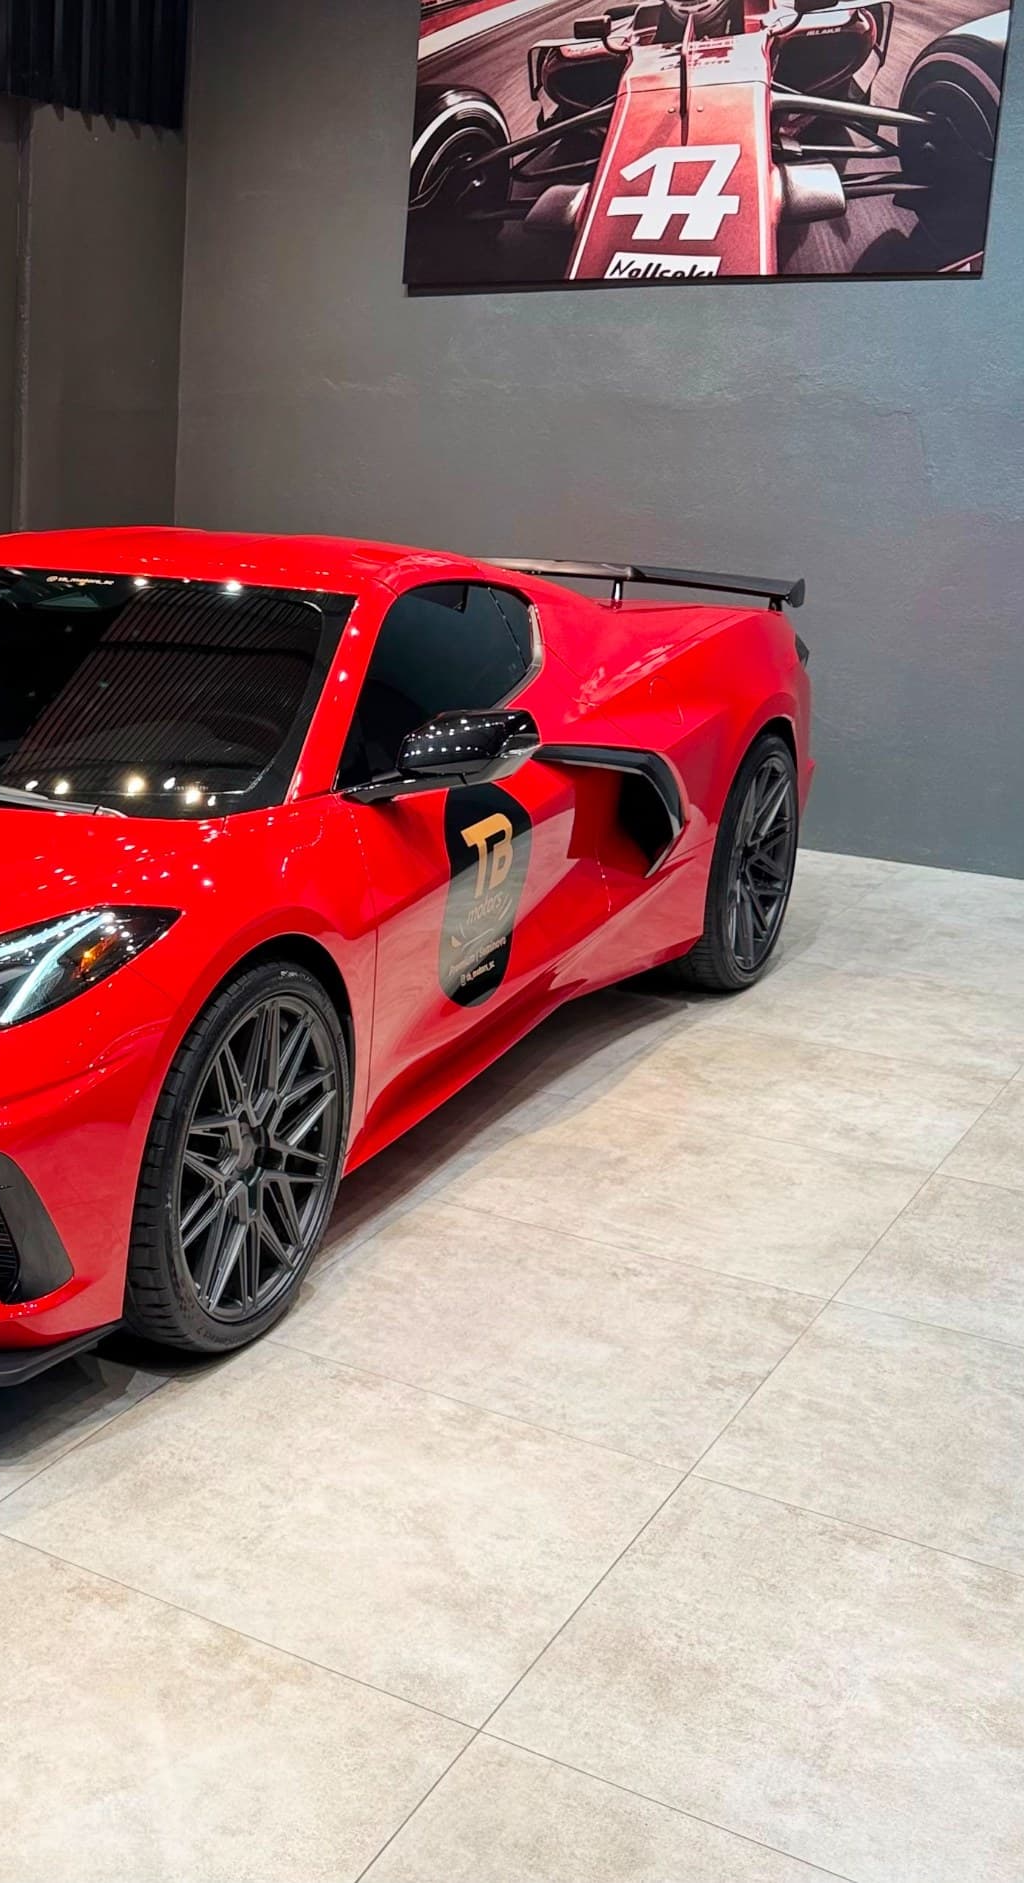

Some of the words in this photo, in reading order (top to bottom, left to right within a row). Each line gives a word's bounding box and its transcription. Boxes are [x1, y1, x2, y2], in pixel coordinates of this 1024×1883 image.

[607, 144, 742, 240] 17
[460, 812, 514, 898] TB
[465, 891, 504, 926] motors
